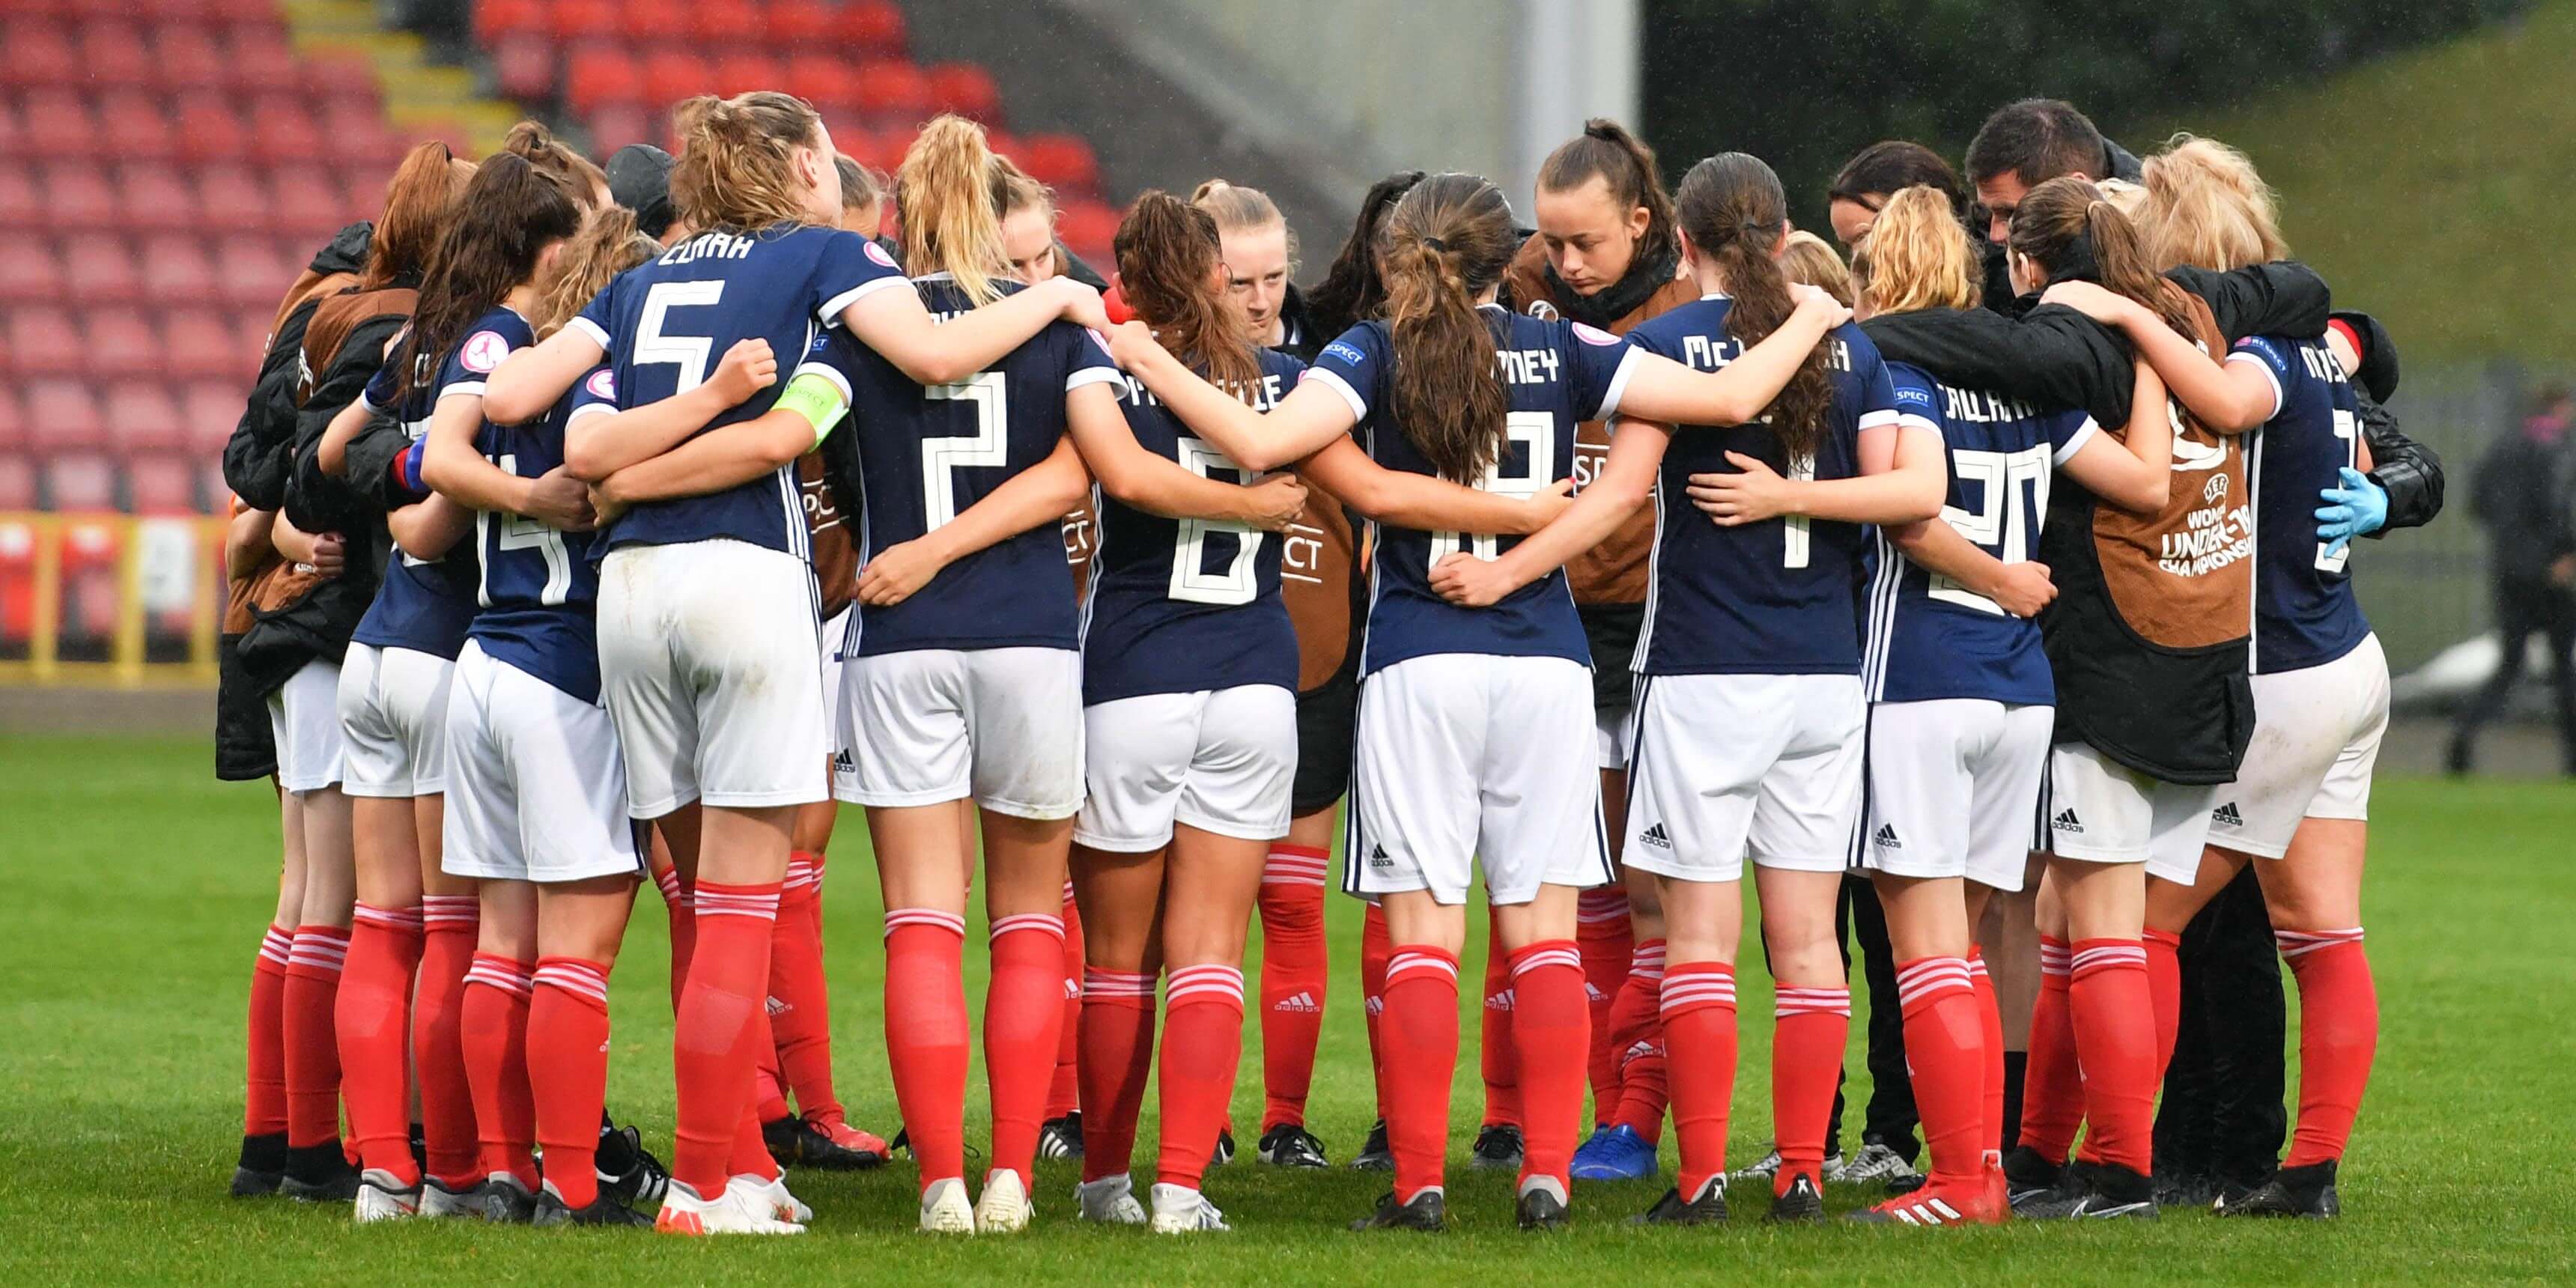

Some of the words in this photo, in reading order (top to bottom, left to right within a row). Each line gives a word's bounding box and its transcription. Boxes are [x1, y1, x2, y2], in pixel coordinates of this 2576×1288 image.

[633, 280, 725, 395] 5
[1896, 392, 1929, 403] SPECT
[922, 371, 1006, 534] 2
[1928, 442, 2053, 619] 20
